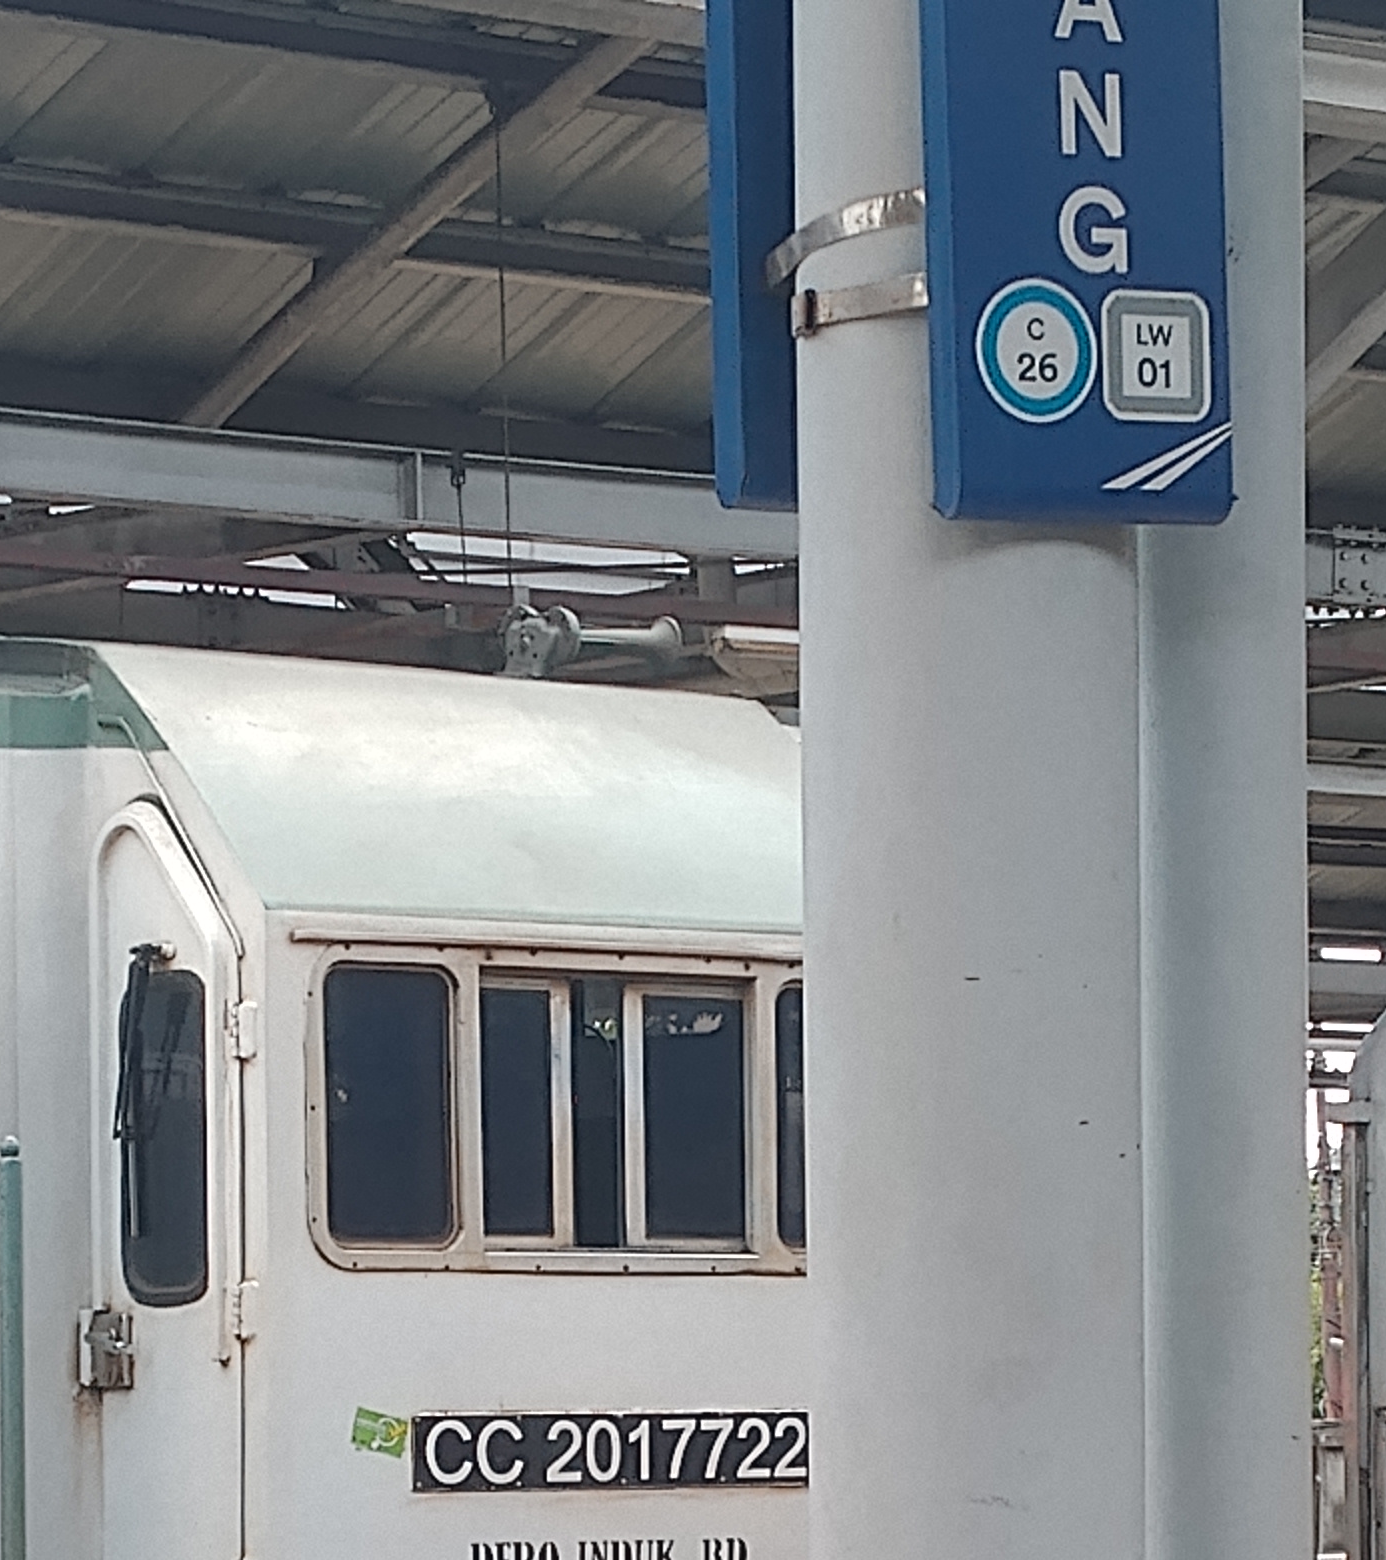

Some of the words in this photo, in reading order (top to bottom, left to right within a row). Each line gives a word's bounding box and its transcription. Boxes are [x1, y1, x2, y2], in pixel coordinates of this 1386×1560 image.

[1026, 317, 1045, 341] C
[1136, 323, 1173, 347] LW
[1016, 353, 1058, 383] 26
[1138, 358, 1171, 388] 01
[424, 1419, 523, 1485] CC
[545, 1416, 808, 1483] 2017722
